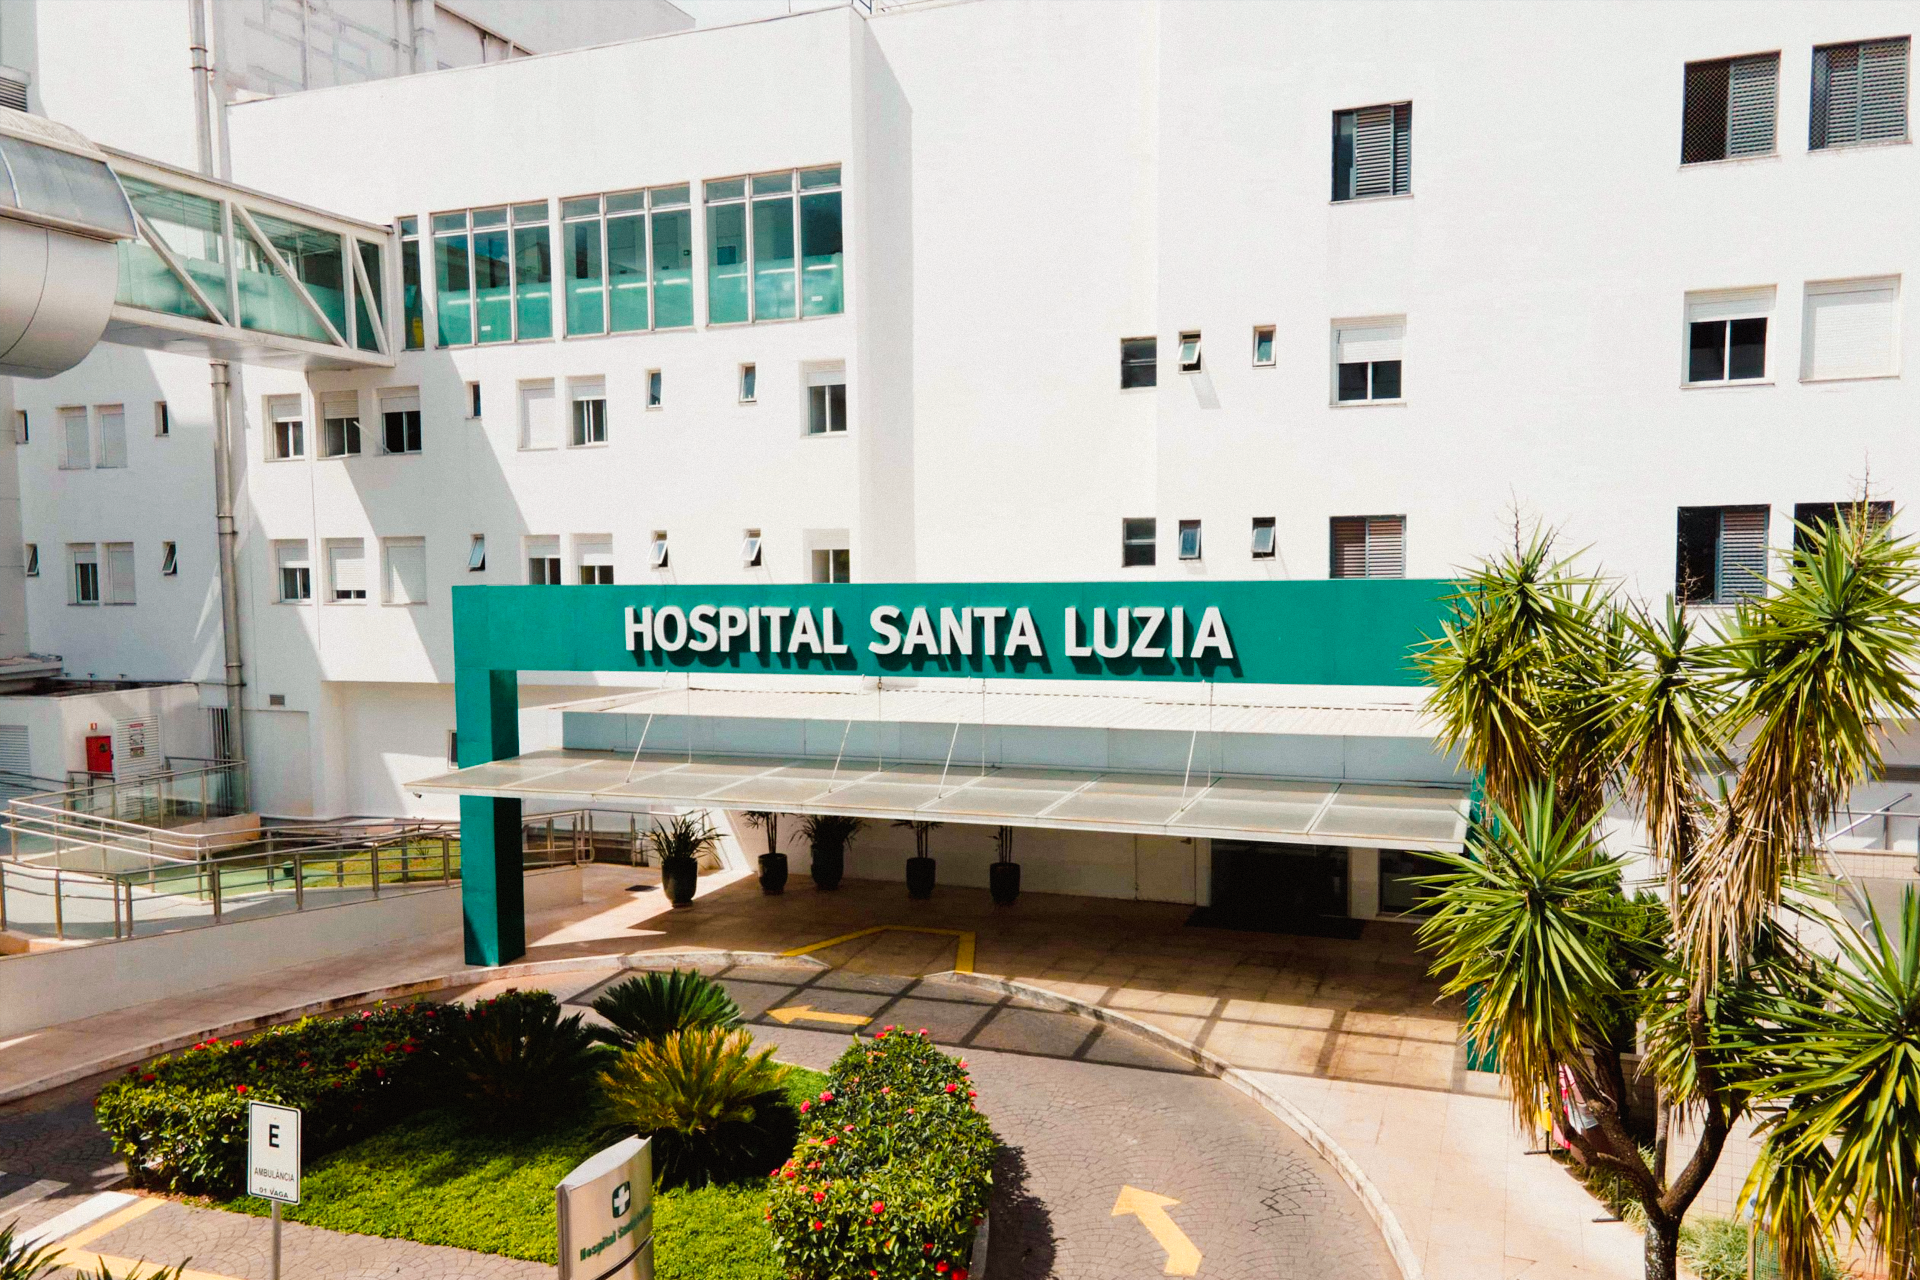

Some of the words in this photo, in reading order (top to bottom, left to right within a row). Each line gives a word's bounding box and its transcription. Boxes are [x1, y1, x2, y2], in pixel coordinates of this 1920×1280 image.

[624, 604, 849, 655] HOSPITAL
[868, 605, 1043, 657] SANTA
[1064, 606, 1233, 659] LUZIA
[269, 1123, 280, 1148] E
[254, 1167, 295, 1182] AMBULÂNCIA
[269, 1187, 289, 1198] VAGA
[580, 1230, 617, 1262] Hospital
